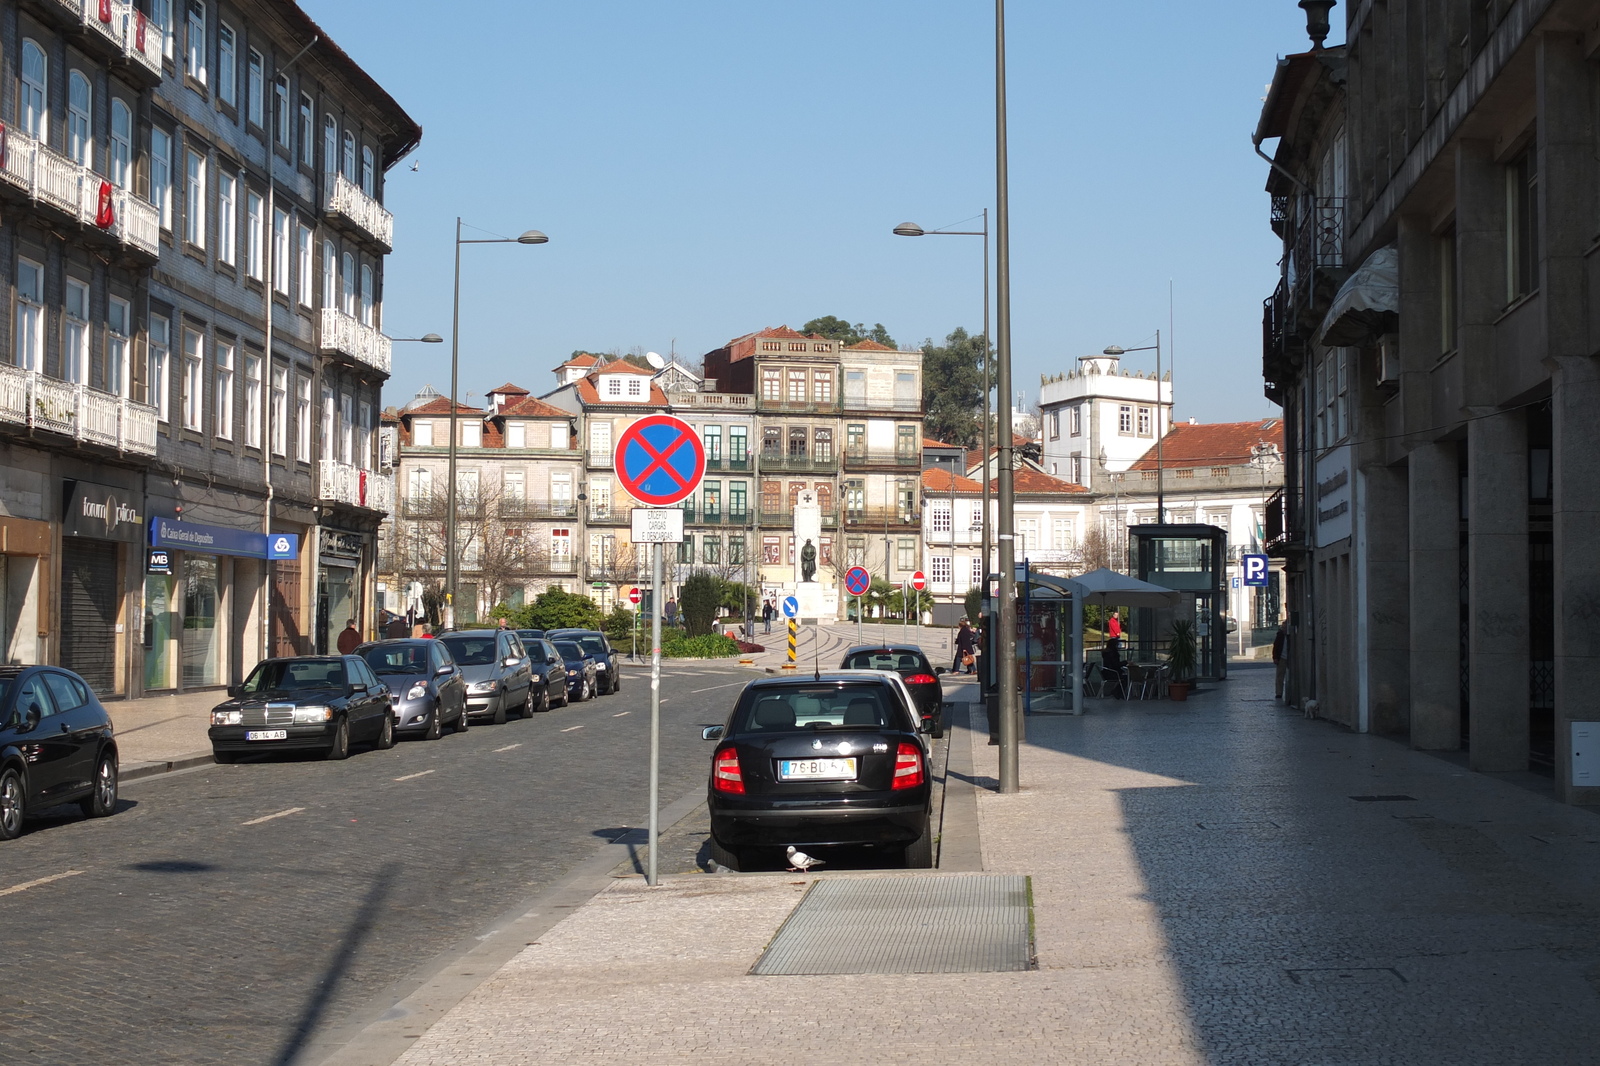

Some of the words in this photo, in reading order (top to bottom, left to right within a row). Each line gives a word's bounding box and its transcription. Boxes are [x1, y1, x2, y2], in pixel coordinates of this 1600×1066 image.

[648, 510, 668, 520] EXCEPTO
[648, 521, 666, 530] CARGAS
[167, 528, 179, 540] Caixa
[178, 529, 190, 542] Geral
[189, 531, 195, 543] de
[642, 532, 646, 540] E
[647, 532, 674, 541] DESCARGAS
[151, 555, 168, 564] MB
[1247, 557, 1264, 579] P
